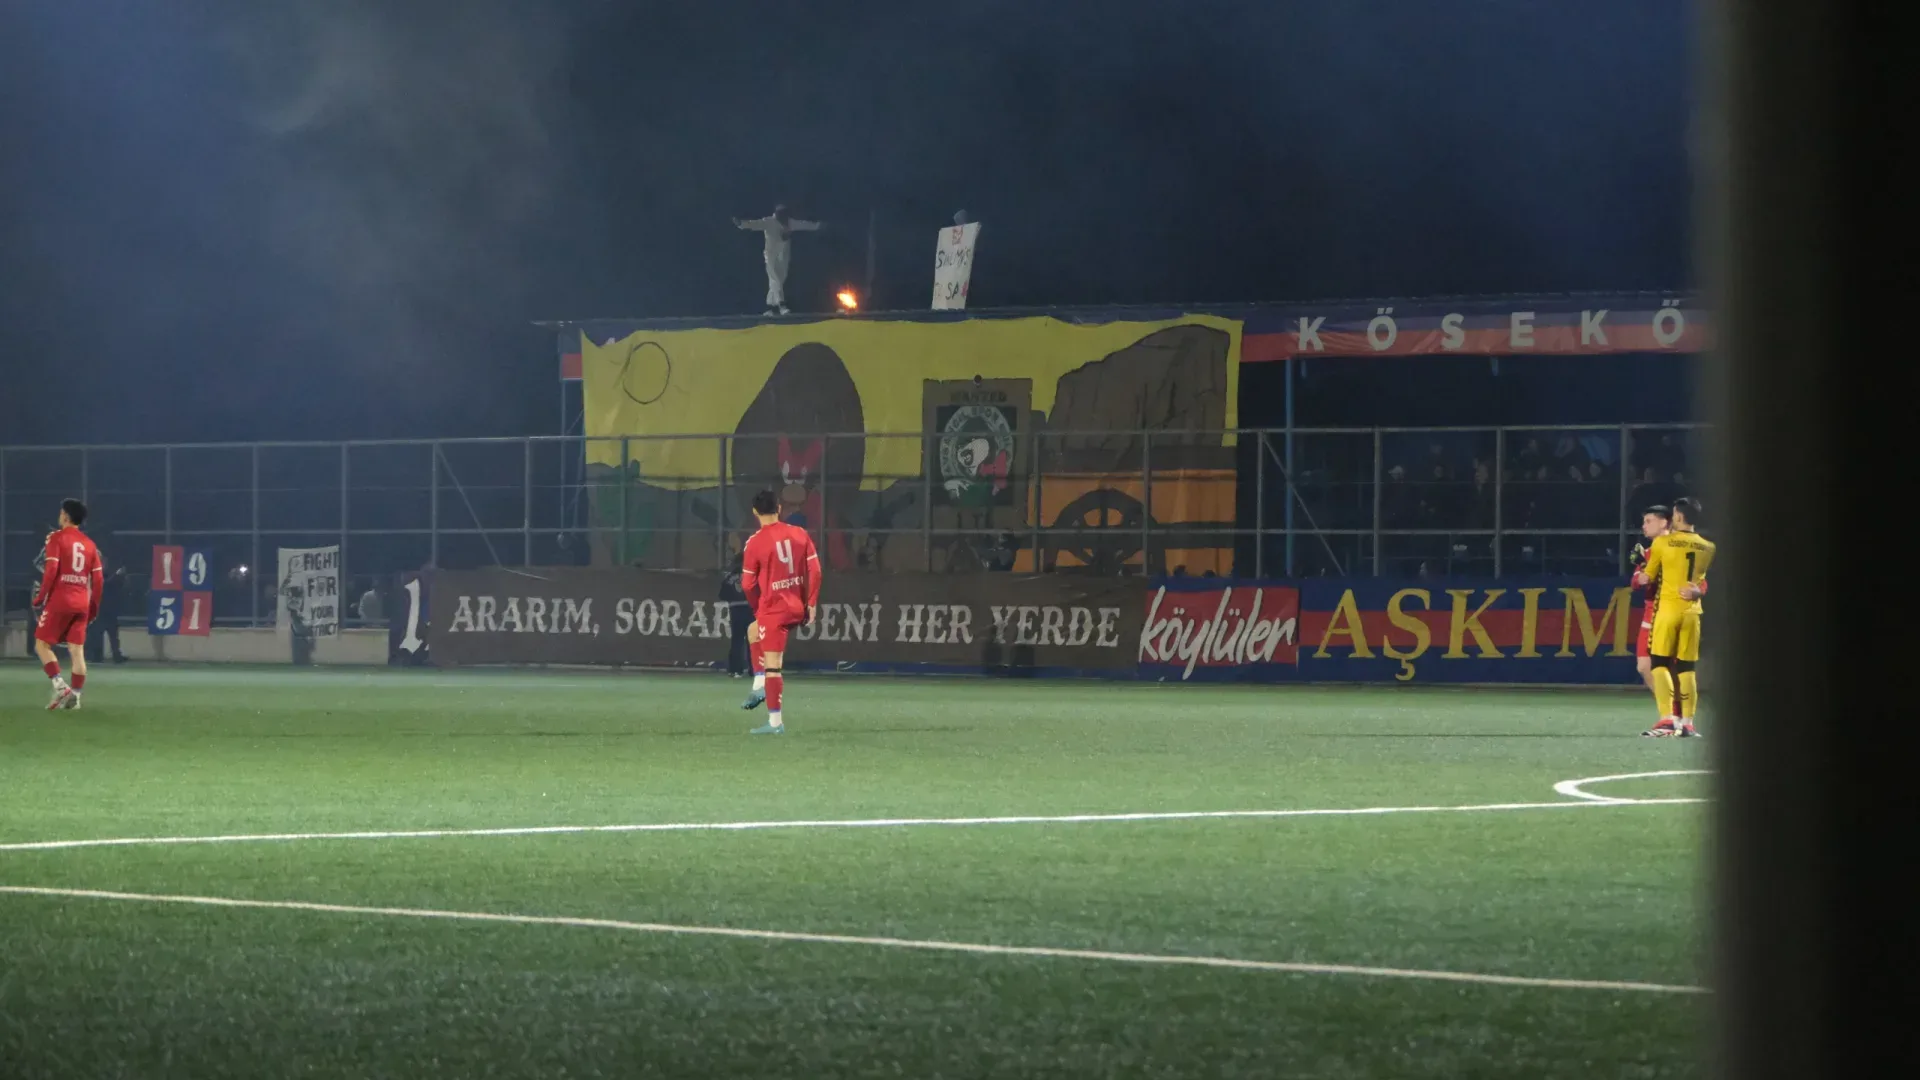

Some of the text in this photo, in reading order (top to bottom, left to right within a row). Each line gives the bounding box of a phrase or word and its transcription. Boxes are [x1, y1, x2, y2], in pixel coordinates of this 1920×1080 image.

[72, 542, 85, 572] 6
[303, 552, 339, 571] FIGHT
[775, 539, 794, 574] 4
[1686, 551, 1696, 582] 1
[307, 576, 337, 598] FOR
[310, 605, 335, 620] YOUR
[449, 596, 600, 637] ARARIM,
[895, 603, 974, 645] HER
[991, 605, 1120, 648] YERDE
[1138, 585, 1297, 680] köylüler
[1312, 587, 1634, 681] AŞKIM
